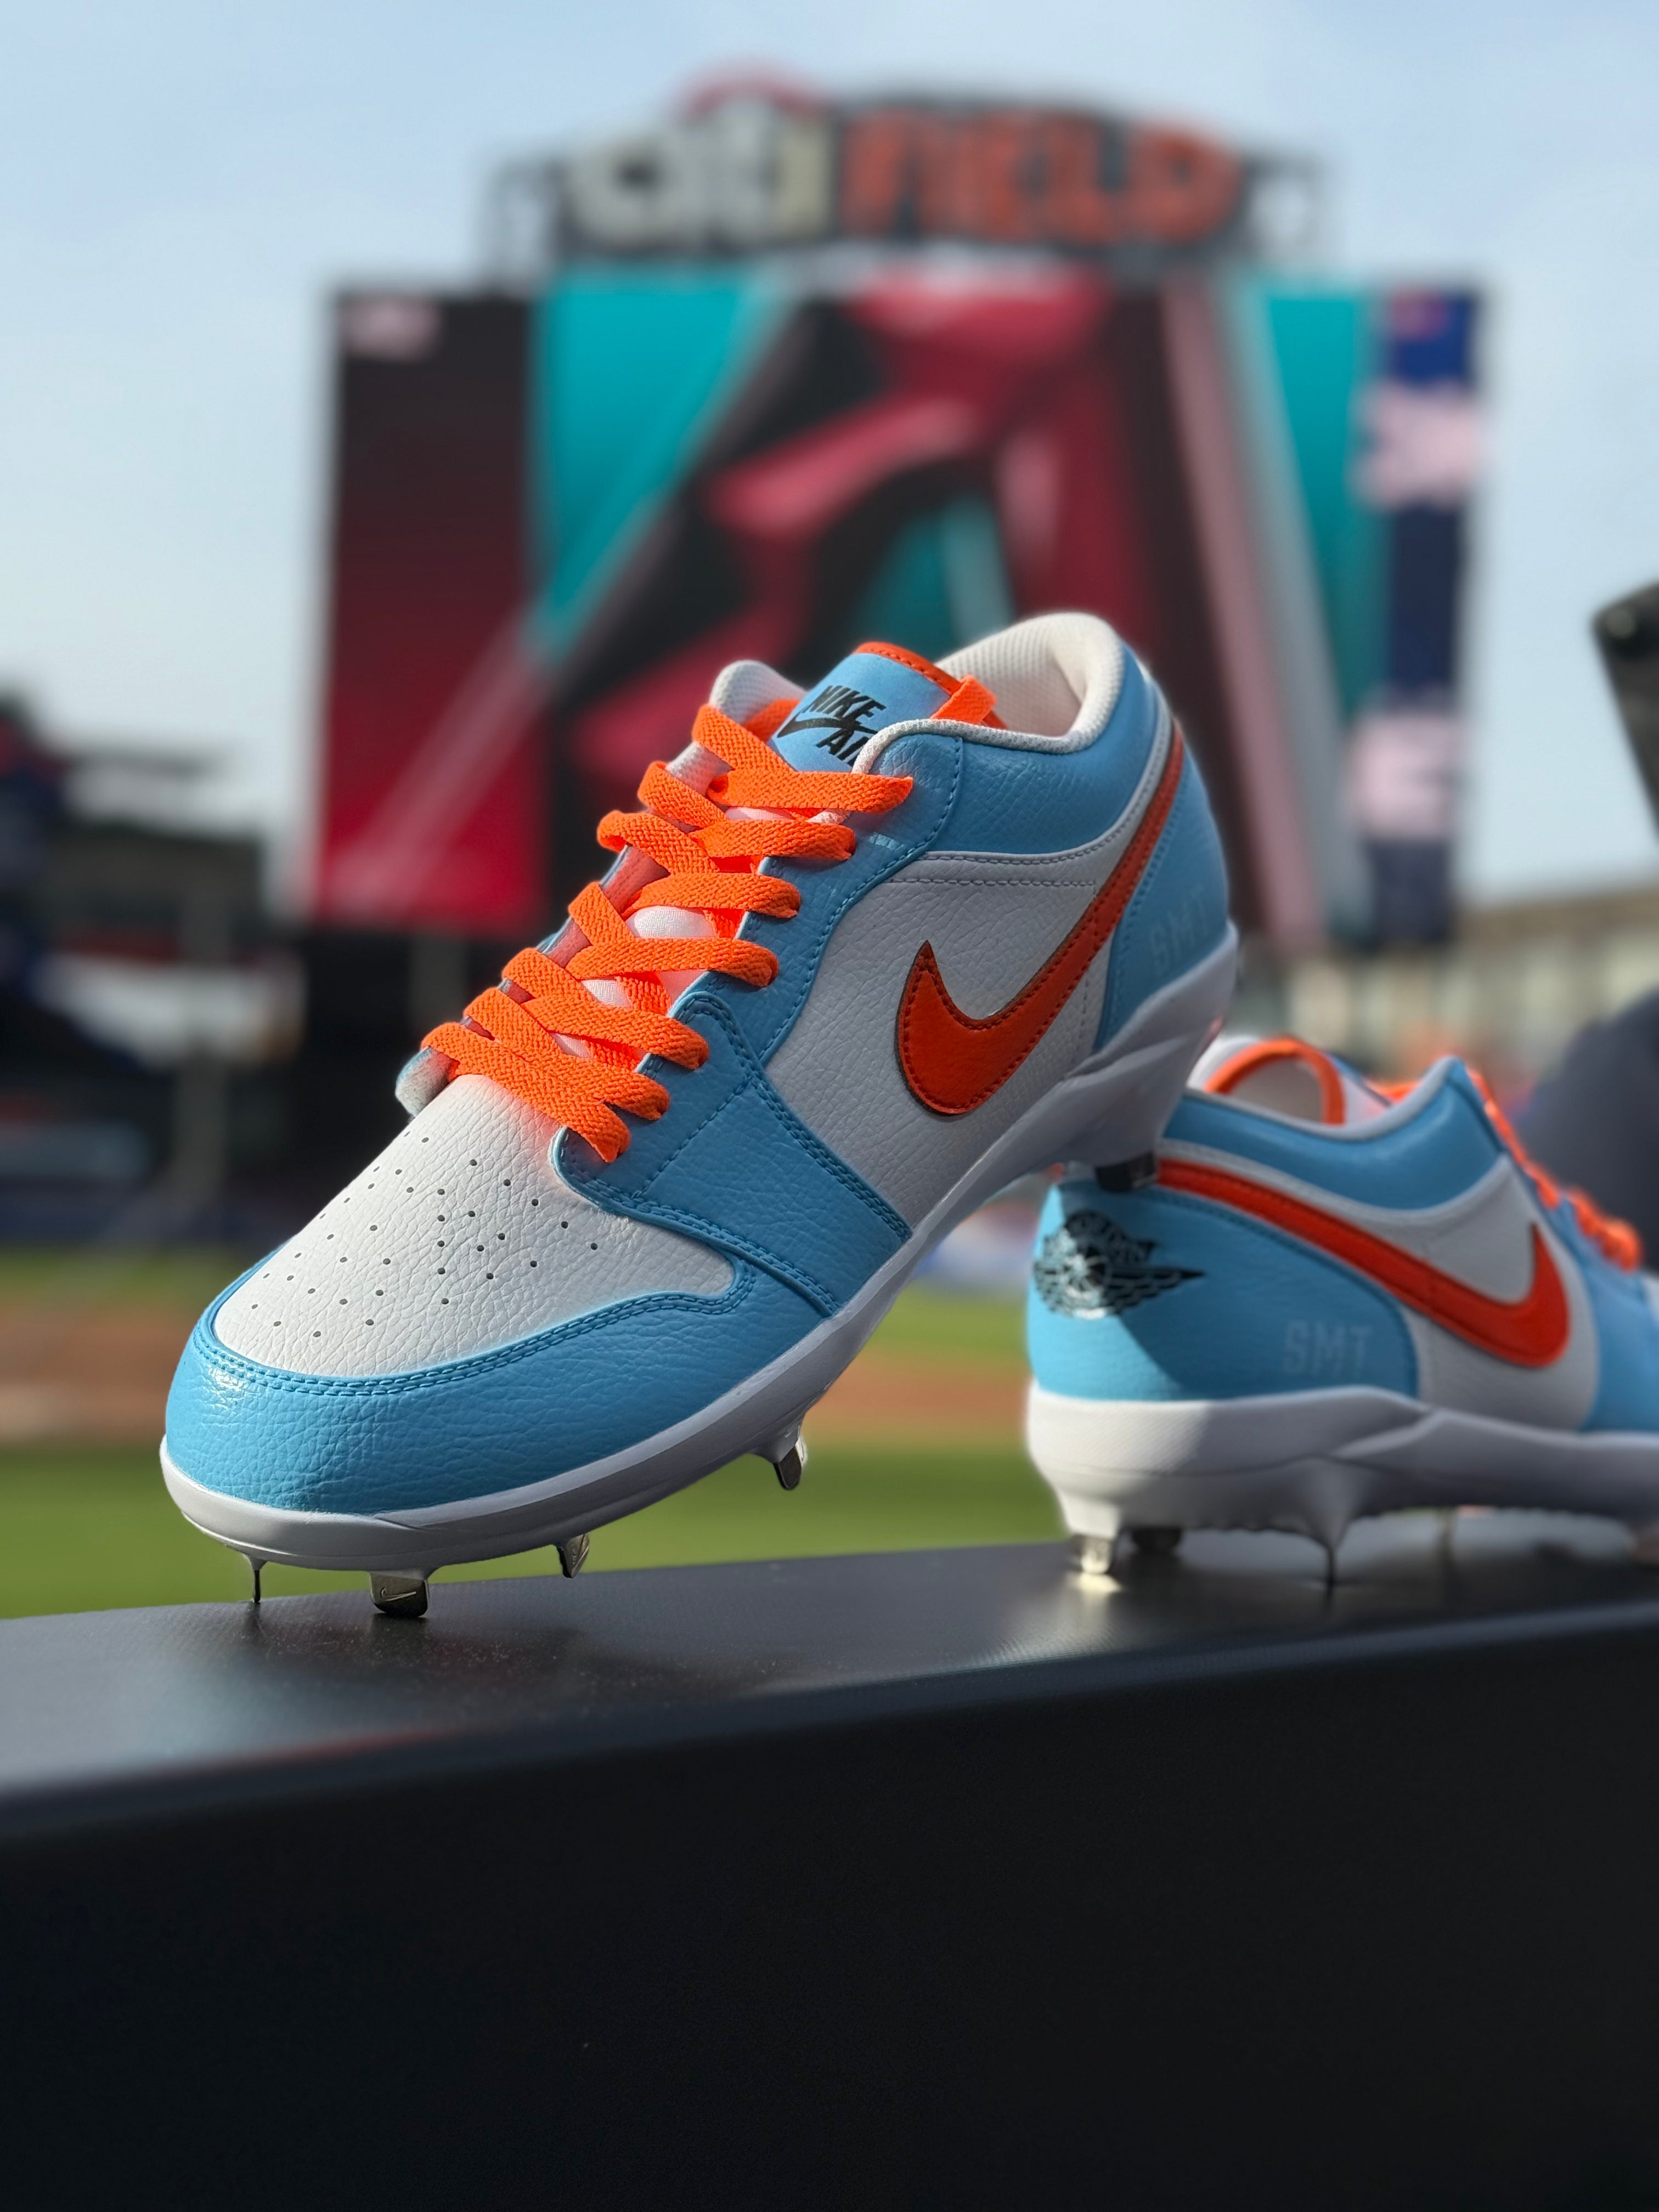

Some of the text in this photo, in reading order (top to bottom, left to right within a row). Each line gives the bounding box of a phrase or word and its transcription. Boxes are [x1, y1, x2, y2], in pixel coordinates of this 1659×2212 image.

[803, 685, 887, 725] NIKE
[815, 725, 869, 766] AI
[1283, 1319, 1372, 1378] SMT
